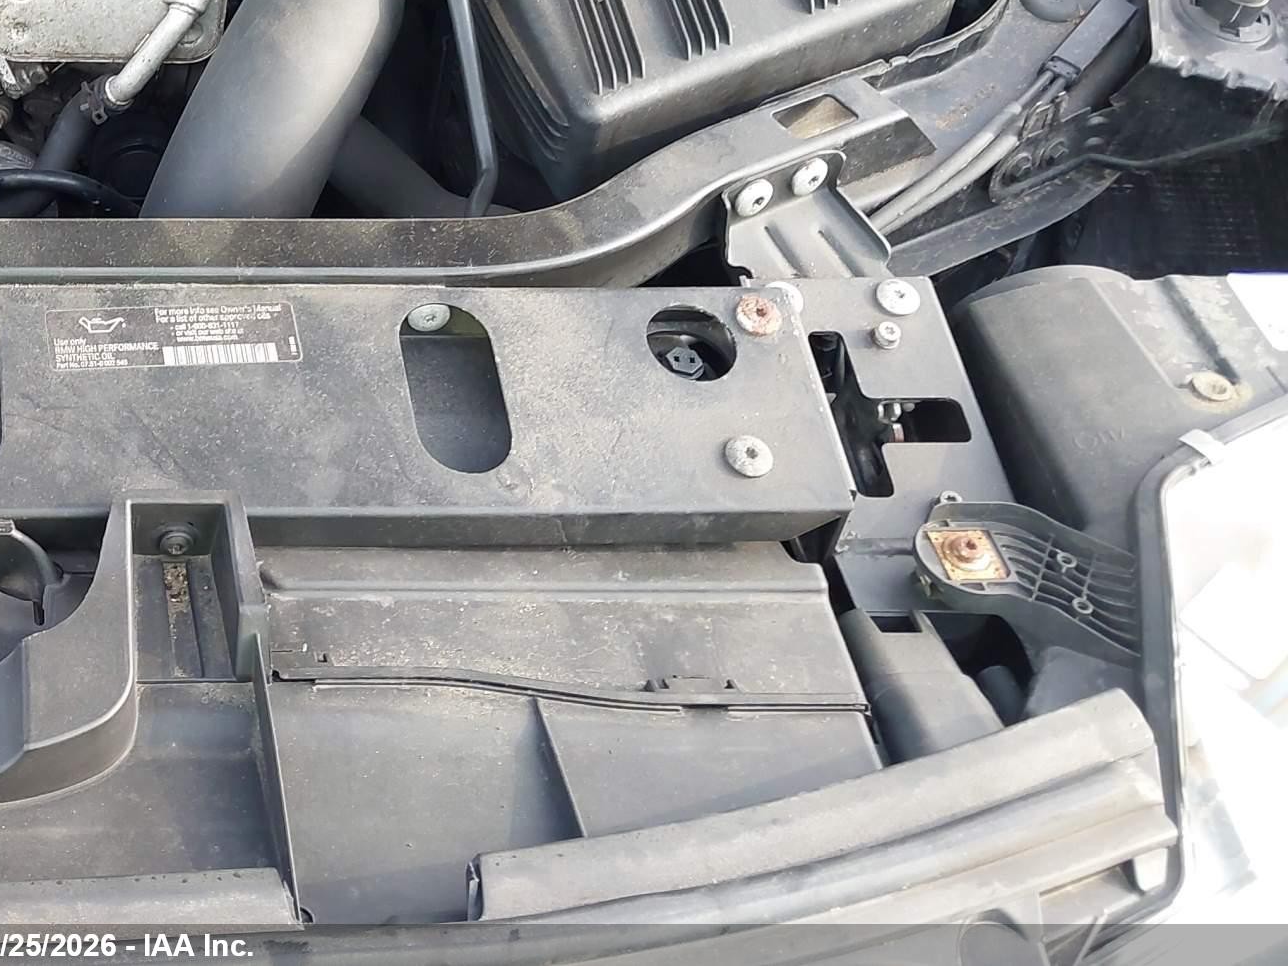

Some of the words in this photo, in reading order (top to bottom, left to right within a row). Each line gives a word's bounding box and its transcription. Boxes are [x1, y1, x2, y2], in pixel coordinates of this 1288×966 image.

[54, 338, 69, 346] Use
[70, 338, 86, 347] only
[55, 345, 76, 354] BMW
[77, 344, 97, 353] HIGH
[98, 342, 160, 352] PERFORMANCE
[56, 353, 101, 362] SYNTHETIC
[101, 352, 116, 361] OIL
